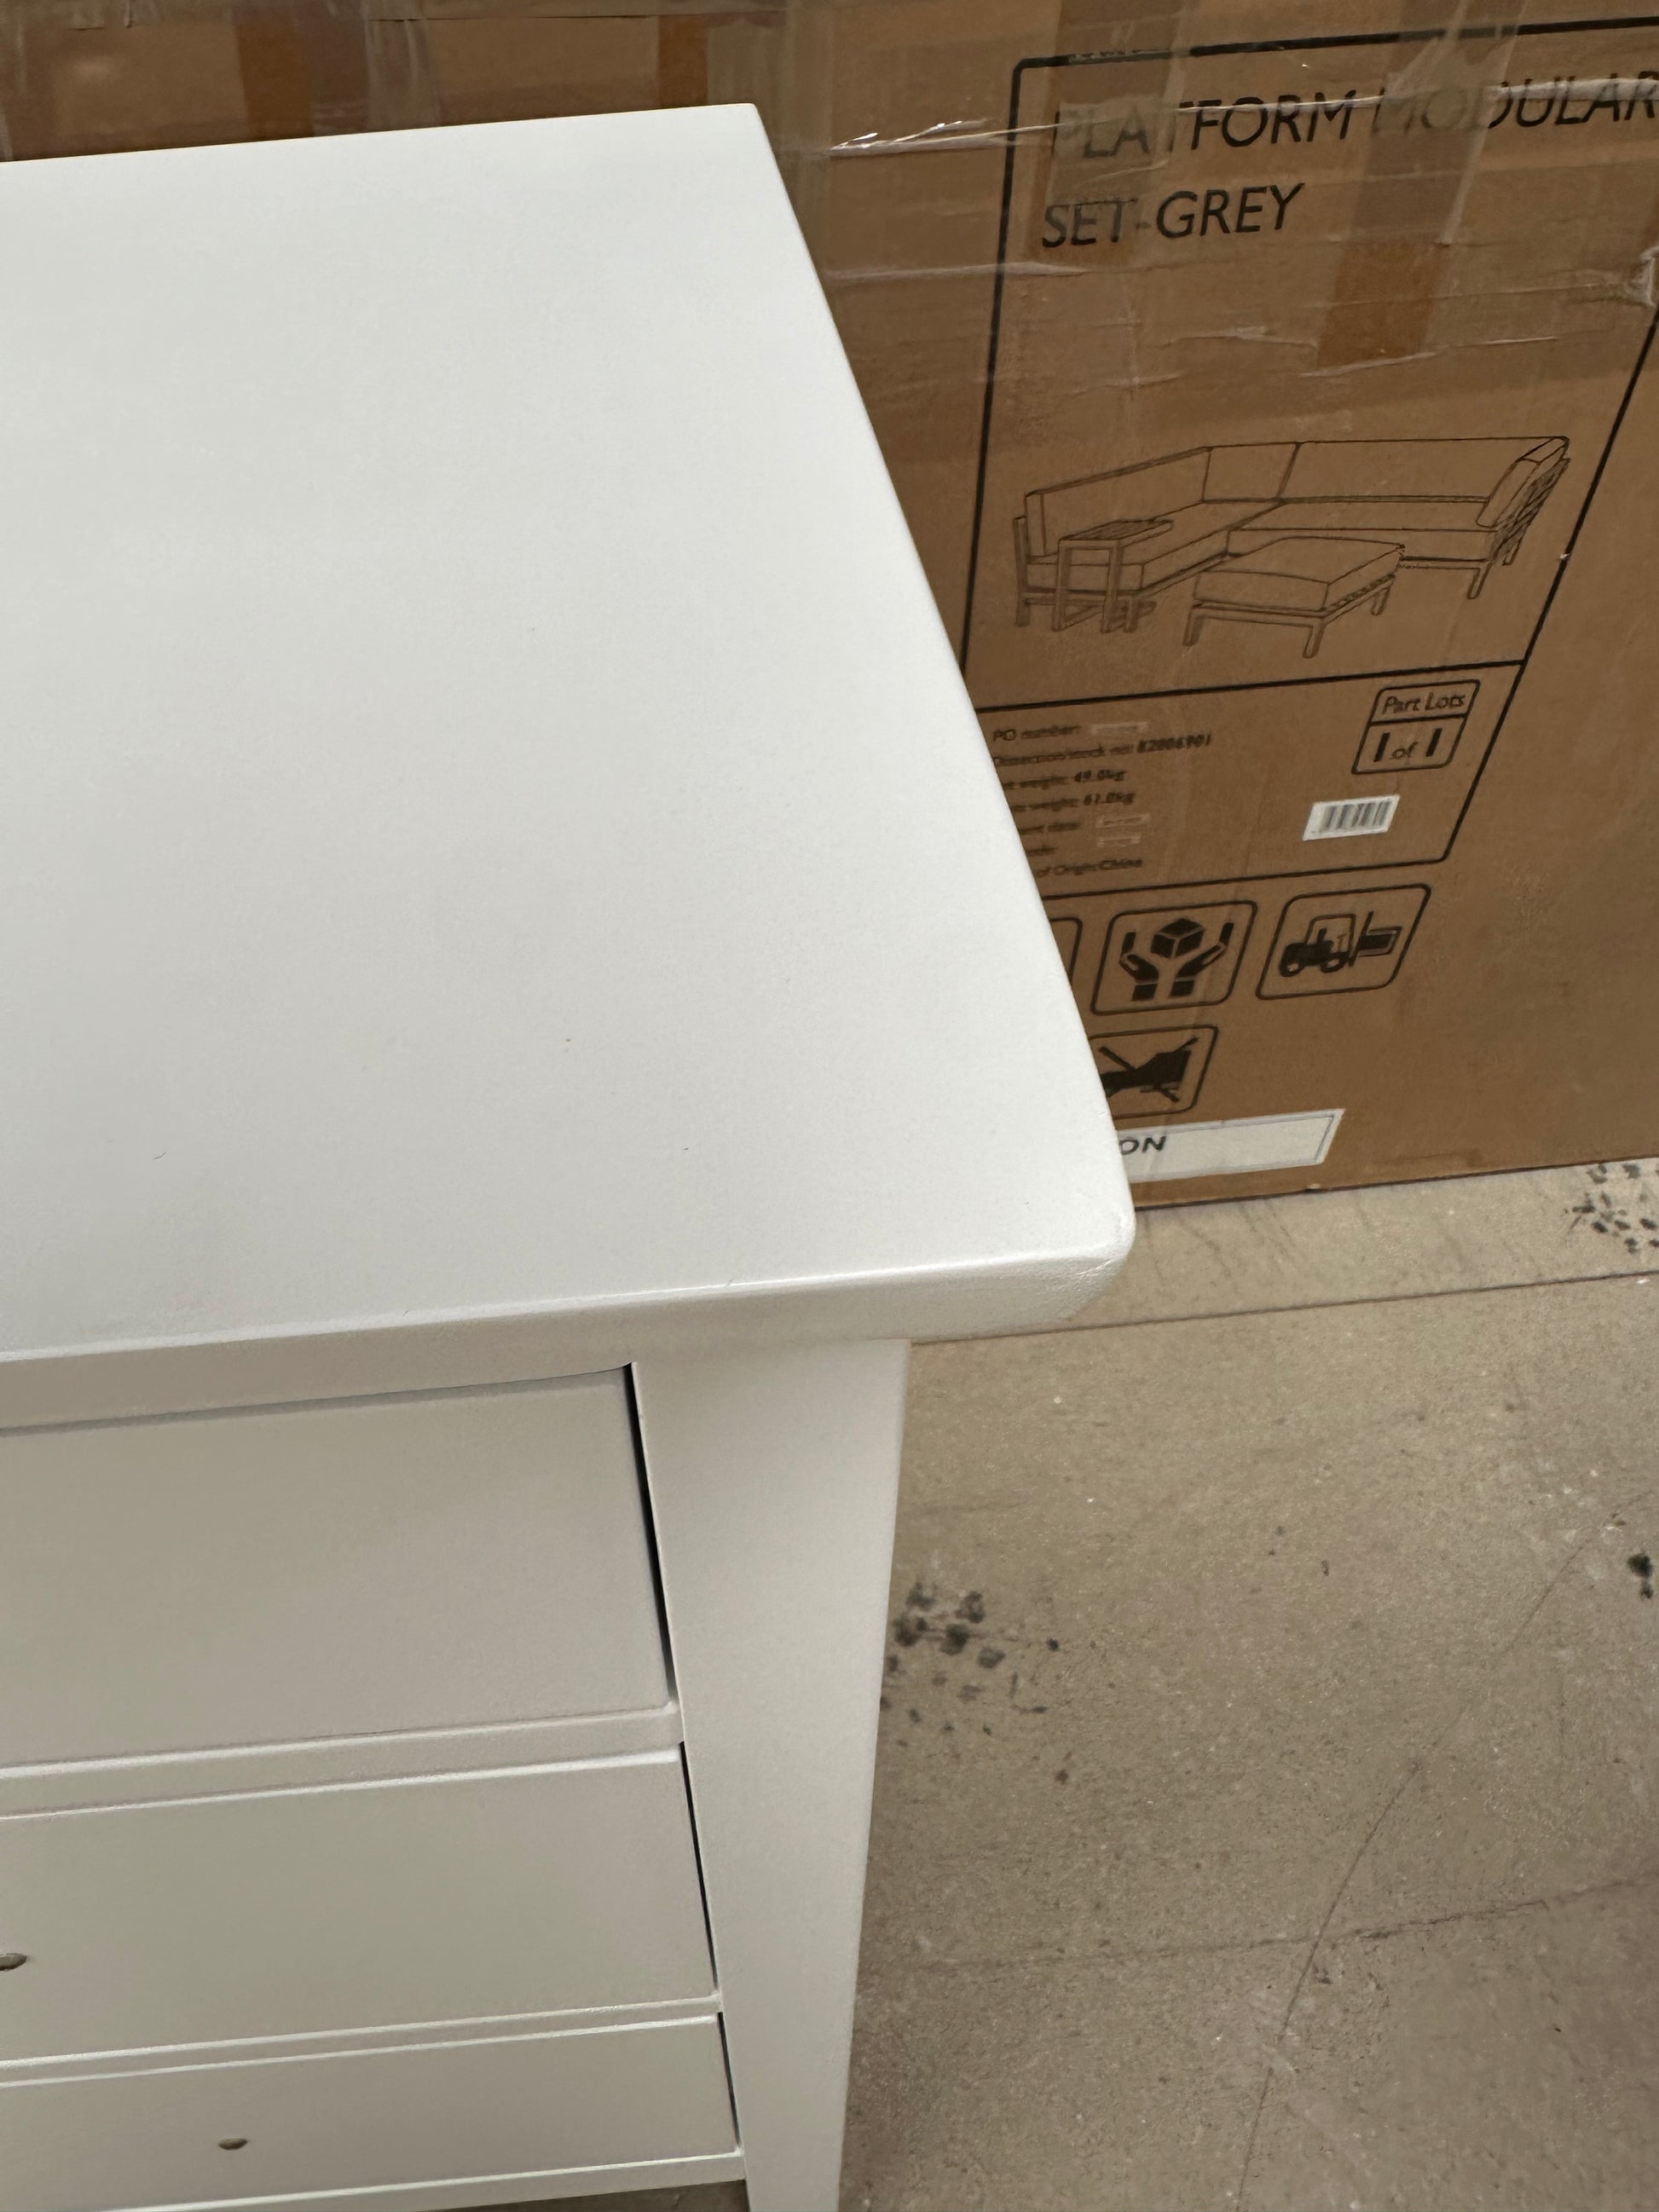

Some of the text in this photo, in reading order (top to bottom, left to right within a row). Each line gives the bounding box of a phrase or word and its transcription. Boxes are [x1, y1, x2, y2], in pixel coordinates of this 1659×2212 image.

[1050, 90, 1356, 159] PLATFORM
[1382, 692, 1465, 714] Part Lots
[992, 728, 1017, 742] PO
